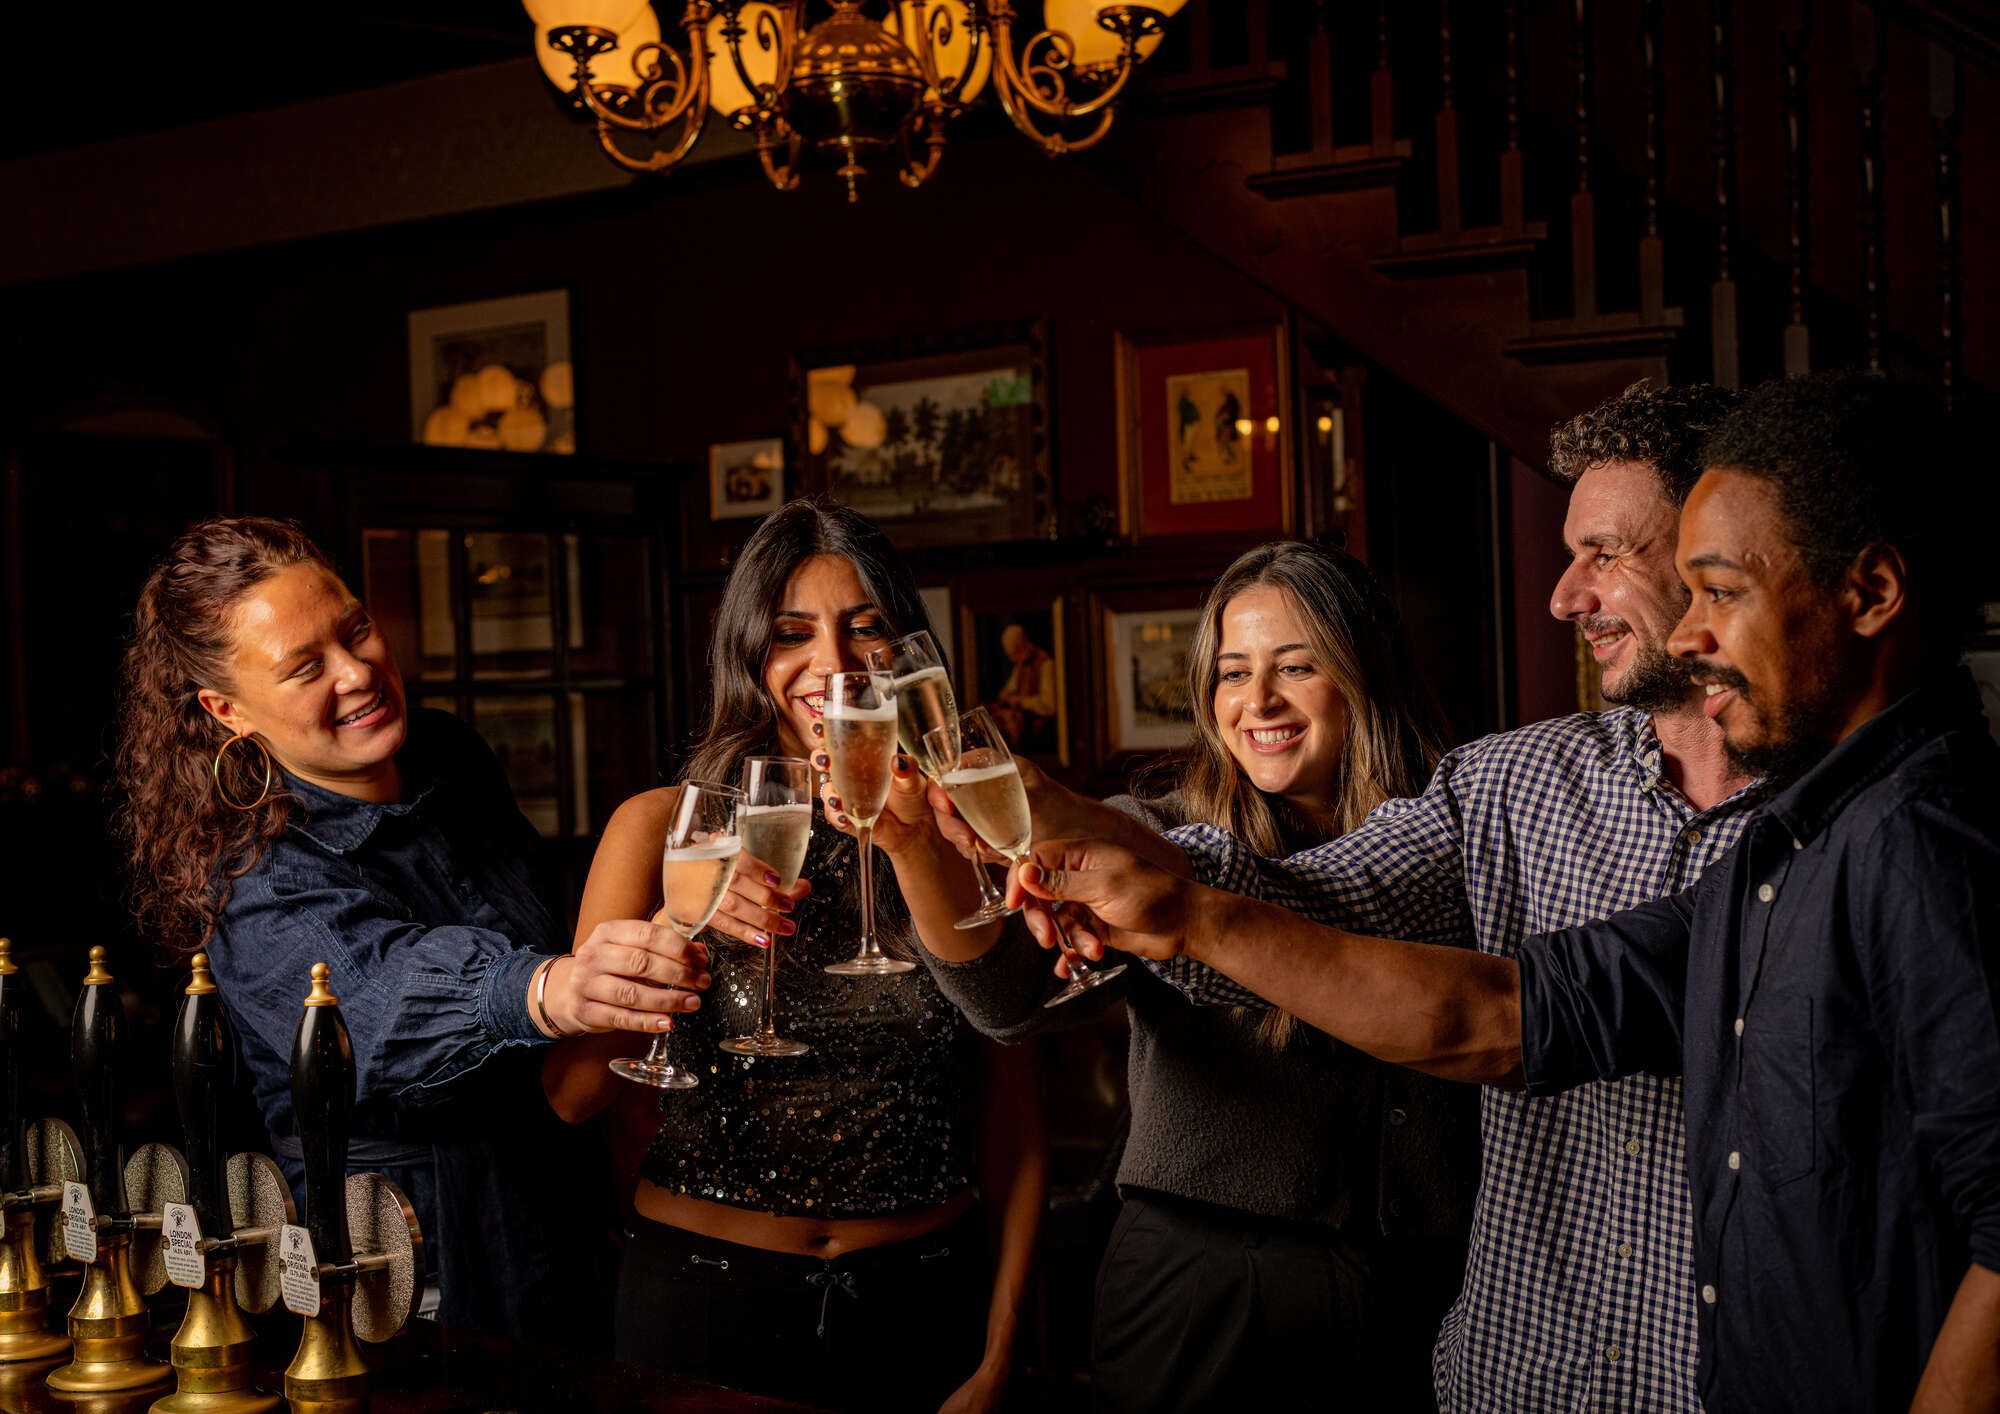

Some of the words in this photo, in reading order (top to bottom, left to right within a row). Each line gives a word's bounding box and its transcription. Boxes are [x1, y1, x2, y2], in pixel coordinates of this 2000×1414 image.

[69, 1207, 86, 1216] LONDON
[170, 1230, 192, 1240] LONDON
[171, 1239, 193, 1249] SPECIAL
[287, 1252, 307, 1263] LONDON
[287, 1259, 309, 1273] ORIGINAL
